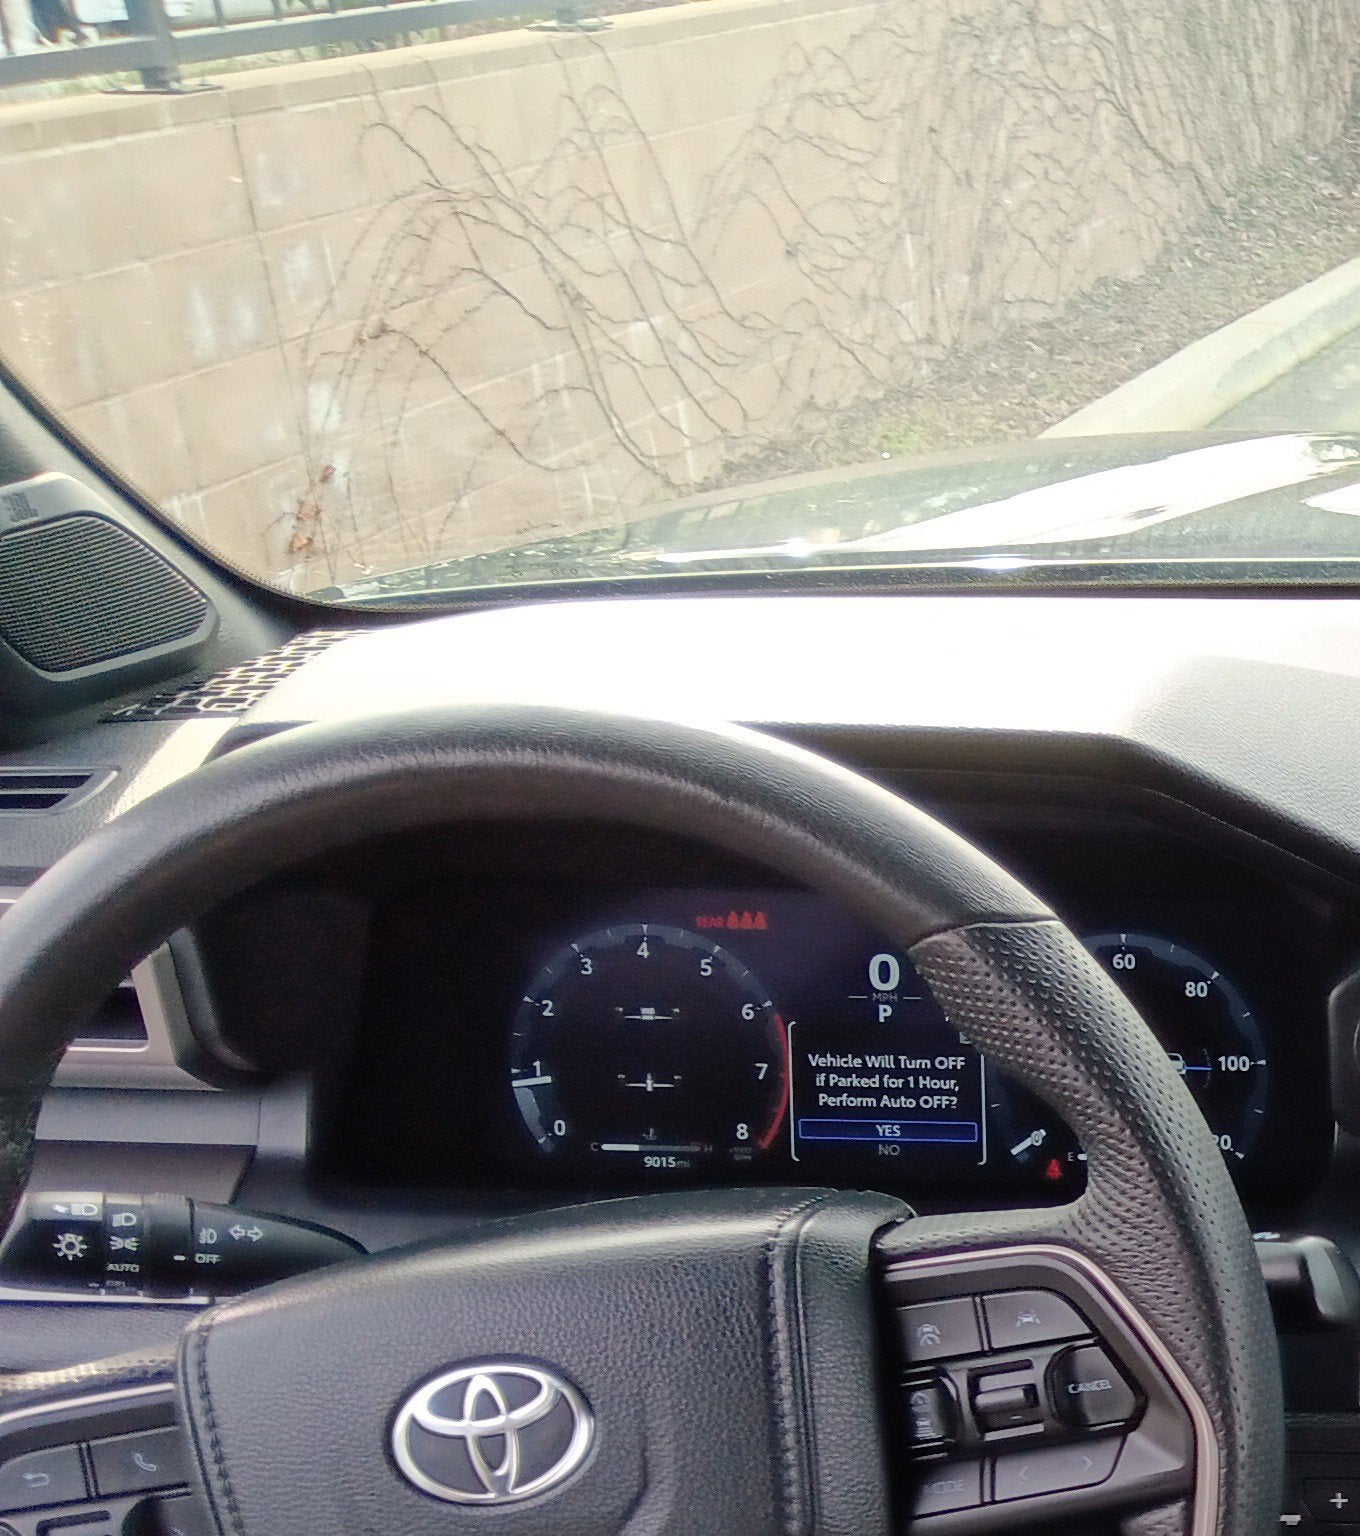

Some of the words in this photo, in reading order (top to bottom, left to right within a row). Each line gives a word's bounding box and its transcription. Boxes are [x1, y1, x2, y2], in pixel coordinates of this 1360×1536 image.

[636, 942, 649, 959] 4
[580, 958, 592, 975] 3
[700, 959, 712, 976] 5
[1112, 954, 1136, 970] 60
[868, 953, 900, 991] 0
[1185, 981, 1208, 998] 80
[541, 1000, 554, 1017] 2
[741, 1004, 754, 1020] 6
[878, 1005, 893, 1022] P
[532, 1061, 541, 1076] 1
[808, 1053, 862, 1069] Vehicle
[865, 1054, 895, 1069] Will
[898, 1056, 931, 1070] Turn
[935, 1056, 966, 1070] OFF
[1217, 1055, 1250, 1072] 100
[755, 1063, 768, 1080] 7
[815, 1074, 826, 1087] if
[829, 1074, 879, 1089] Parked
[883, 1074, 904, 1089] for
[907, 1076, 915, 1089] 1
[919, 1077, 960, 1092] Hour,
[818, 1094, 877, 1108] Perform
[880, 1095, 917, 1109] Auto
[919, 1096, 958, 1110] OFF?
[553, 1119, 567, 1136] 0
[736, 1123, 749, 1140] 8
[876, 1124, 901, 1138] YES
[1031, 1130, 1043, 1147] 0
[878, 1144, 901, 1157] NO
[643, 1156, 676, 1168] 9015
[194, 1253, 222, 1264] OFF
[106, 1262, 140, 1273] AUTO
